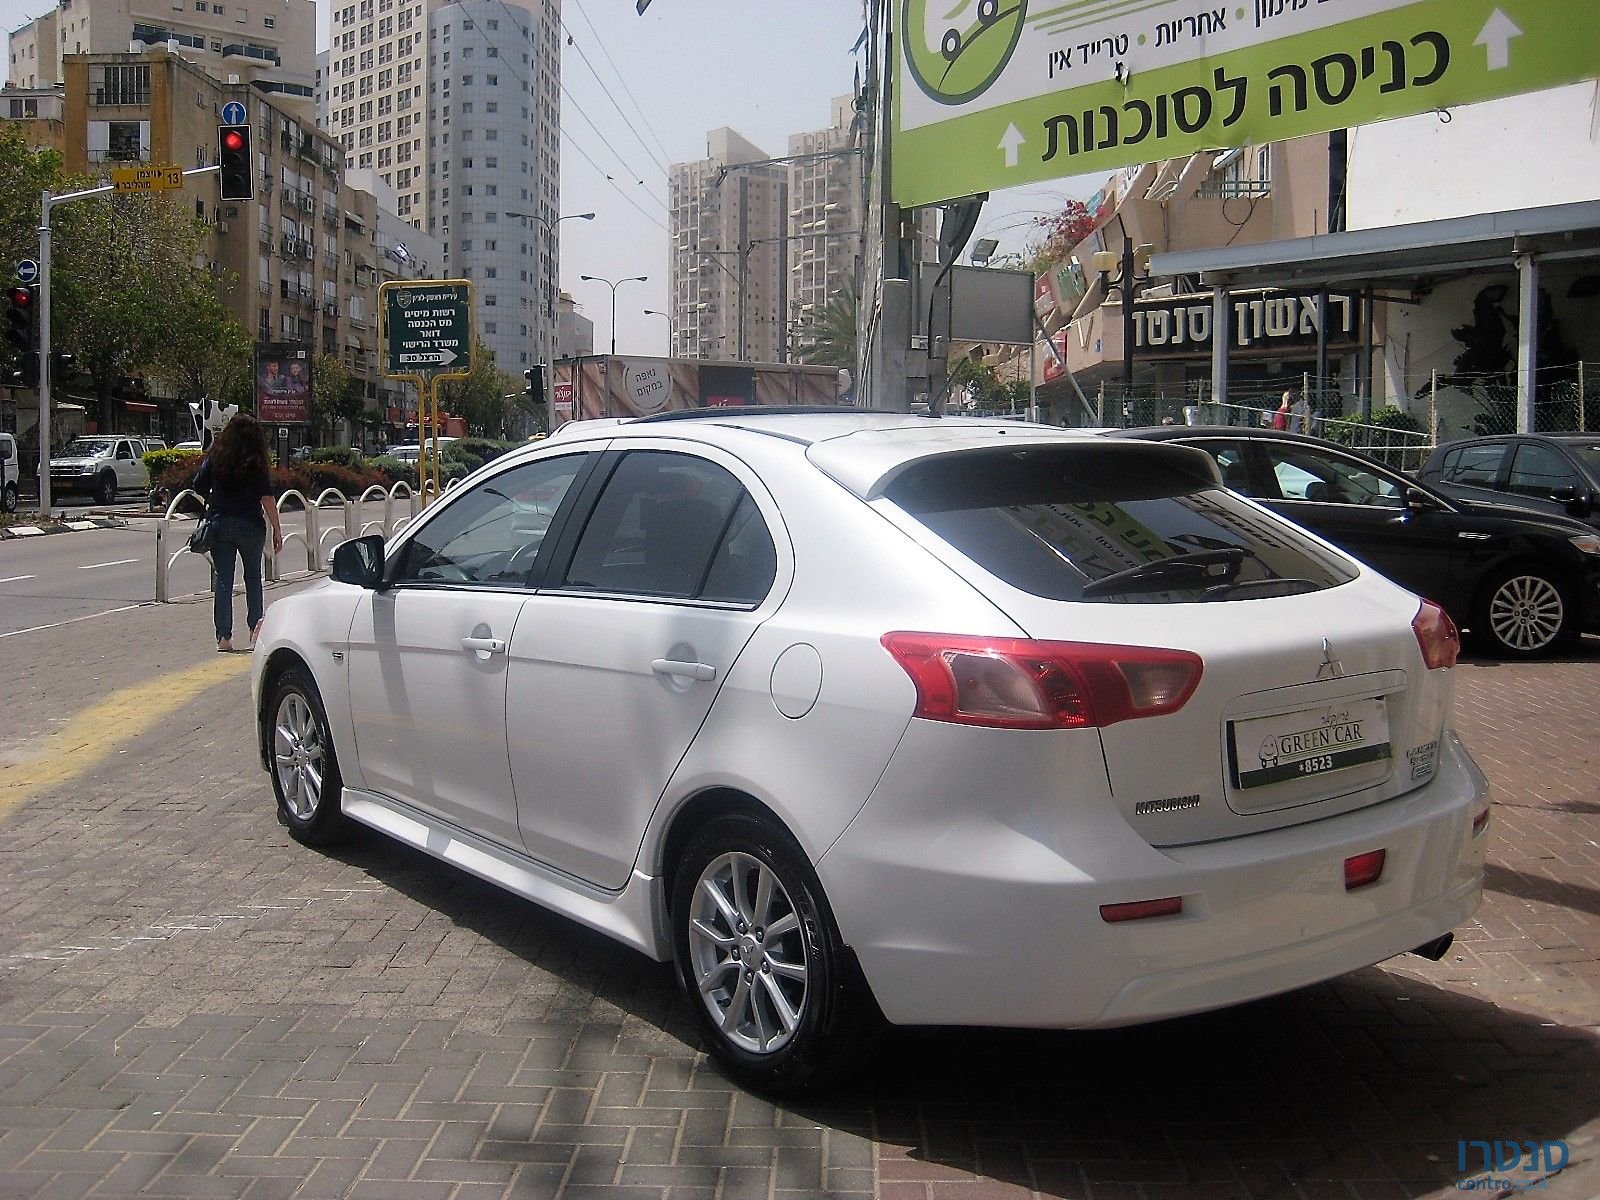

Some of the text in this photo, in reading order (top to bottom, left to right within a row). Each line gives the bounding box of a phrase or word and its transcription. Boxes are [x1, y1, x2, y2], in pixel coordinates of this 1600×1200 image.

[1155, 7, 1227, 48] אחריות
[1077, 33, 1130, 65] טרייד
[1048, 46, 1072, 79] אין
[1041, 31, 1451, 162] כניסה לסוכנות
[136, 170, 158, 180] ויצמן
[167, 173, 179, 185] 13
[404, 308, 456, 318] רשות מיסים
[1235, 294, 1351, 346] ראשון
[407, 319, 453, 328] מס הכנסה
[419, 329, 441, 338] דואר
[402, 339, 459, 349] משרד הרישוי
[406, 353, 441, 362] הרצל 30
[635, 368, 656, 383] נאפה
[636, 381, 663, 397] במקום
[1281, 723, 1363, 754] GREEN CAR
[1136, 794, 1200, 815] MITSUBISHI
